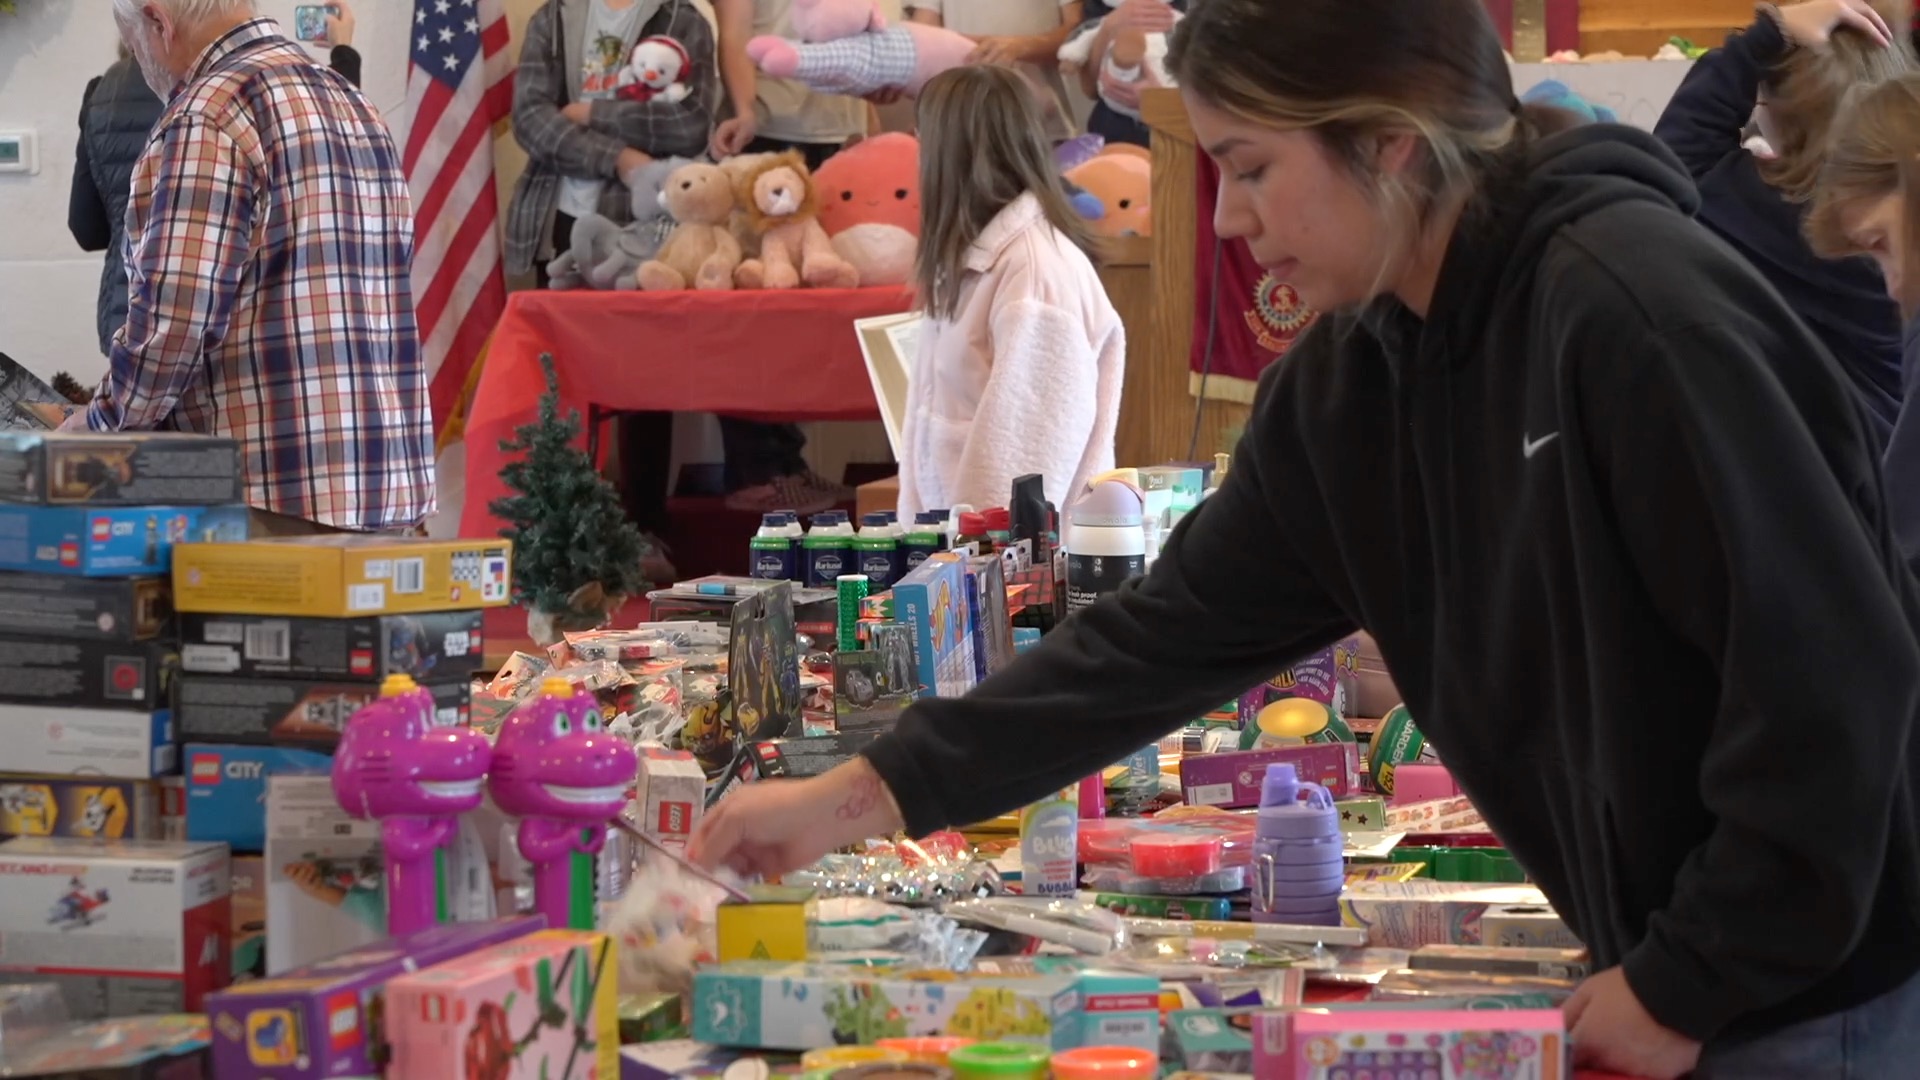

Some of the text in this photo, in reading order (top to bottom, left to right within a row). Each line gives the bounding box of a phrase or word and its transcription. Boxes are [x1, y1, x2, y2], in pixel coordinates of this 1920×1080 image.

[814, 559, 843, 570] Barbasol
[863, 562, 891, 572] Barbasol
[225, 762, 264, 779] CITY
[669, 804, 682, 831] LEGO
